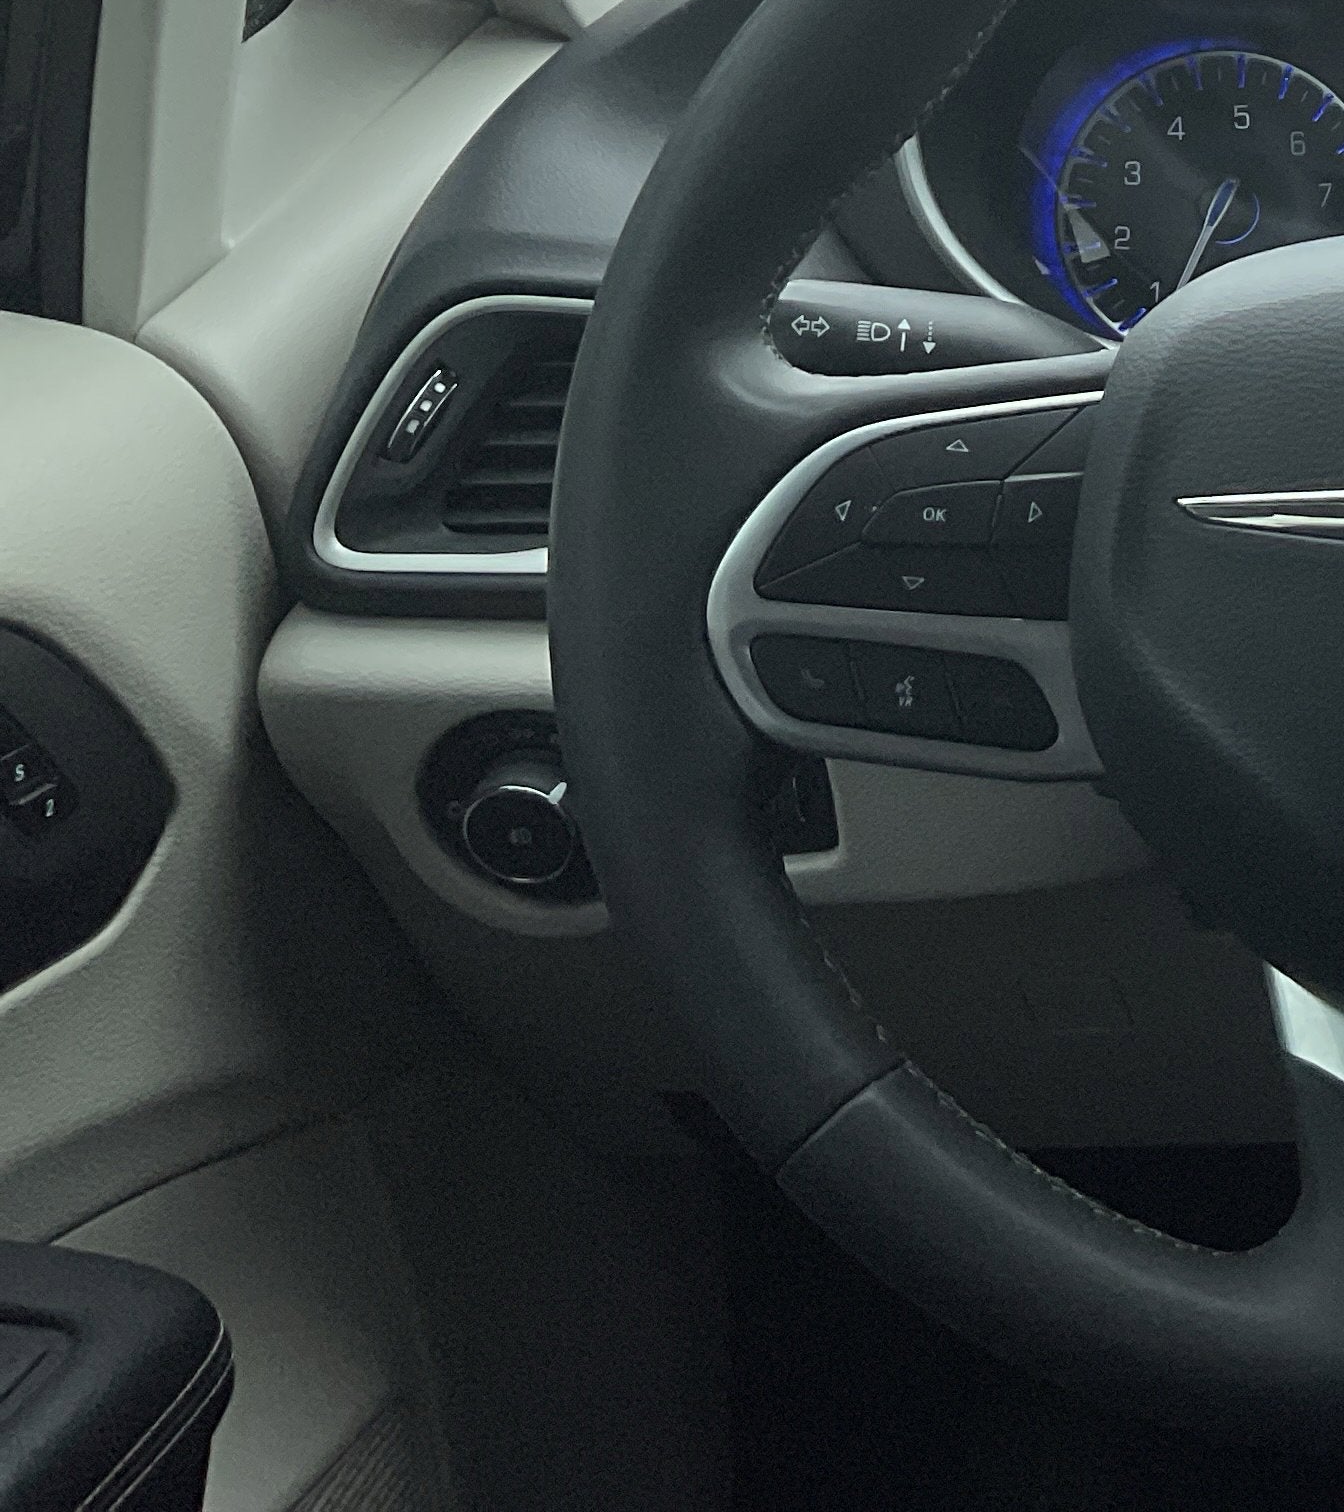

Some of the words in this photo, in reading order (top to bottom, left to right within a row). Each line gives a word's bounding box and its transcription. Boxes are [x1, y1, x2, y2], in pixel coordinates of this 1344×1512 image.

[1166, 116, 1186, 141] 4
[1233, 104, 1251, 130] 5
[1290, 131, 1306, 156] 6
[1123, 160, 1142, 186] 3
[1318, 183, 1333, 208] 7
[1113, 225, 1132, 251] 2
[922, 507, 946, 523] OK
